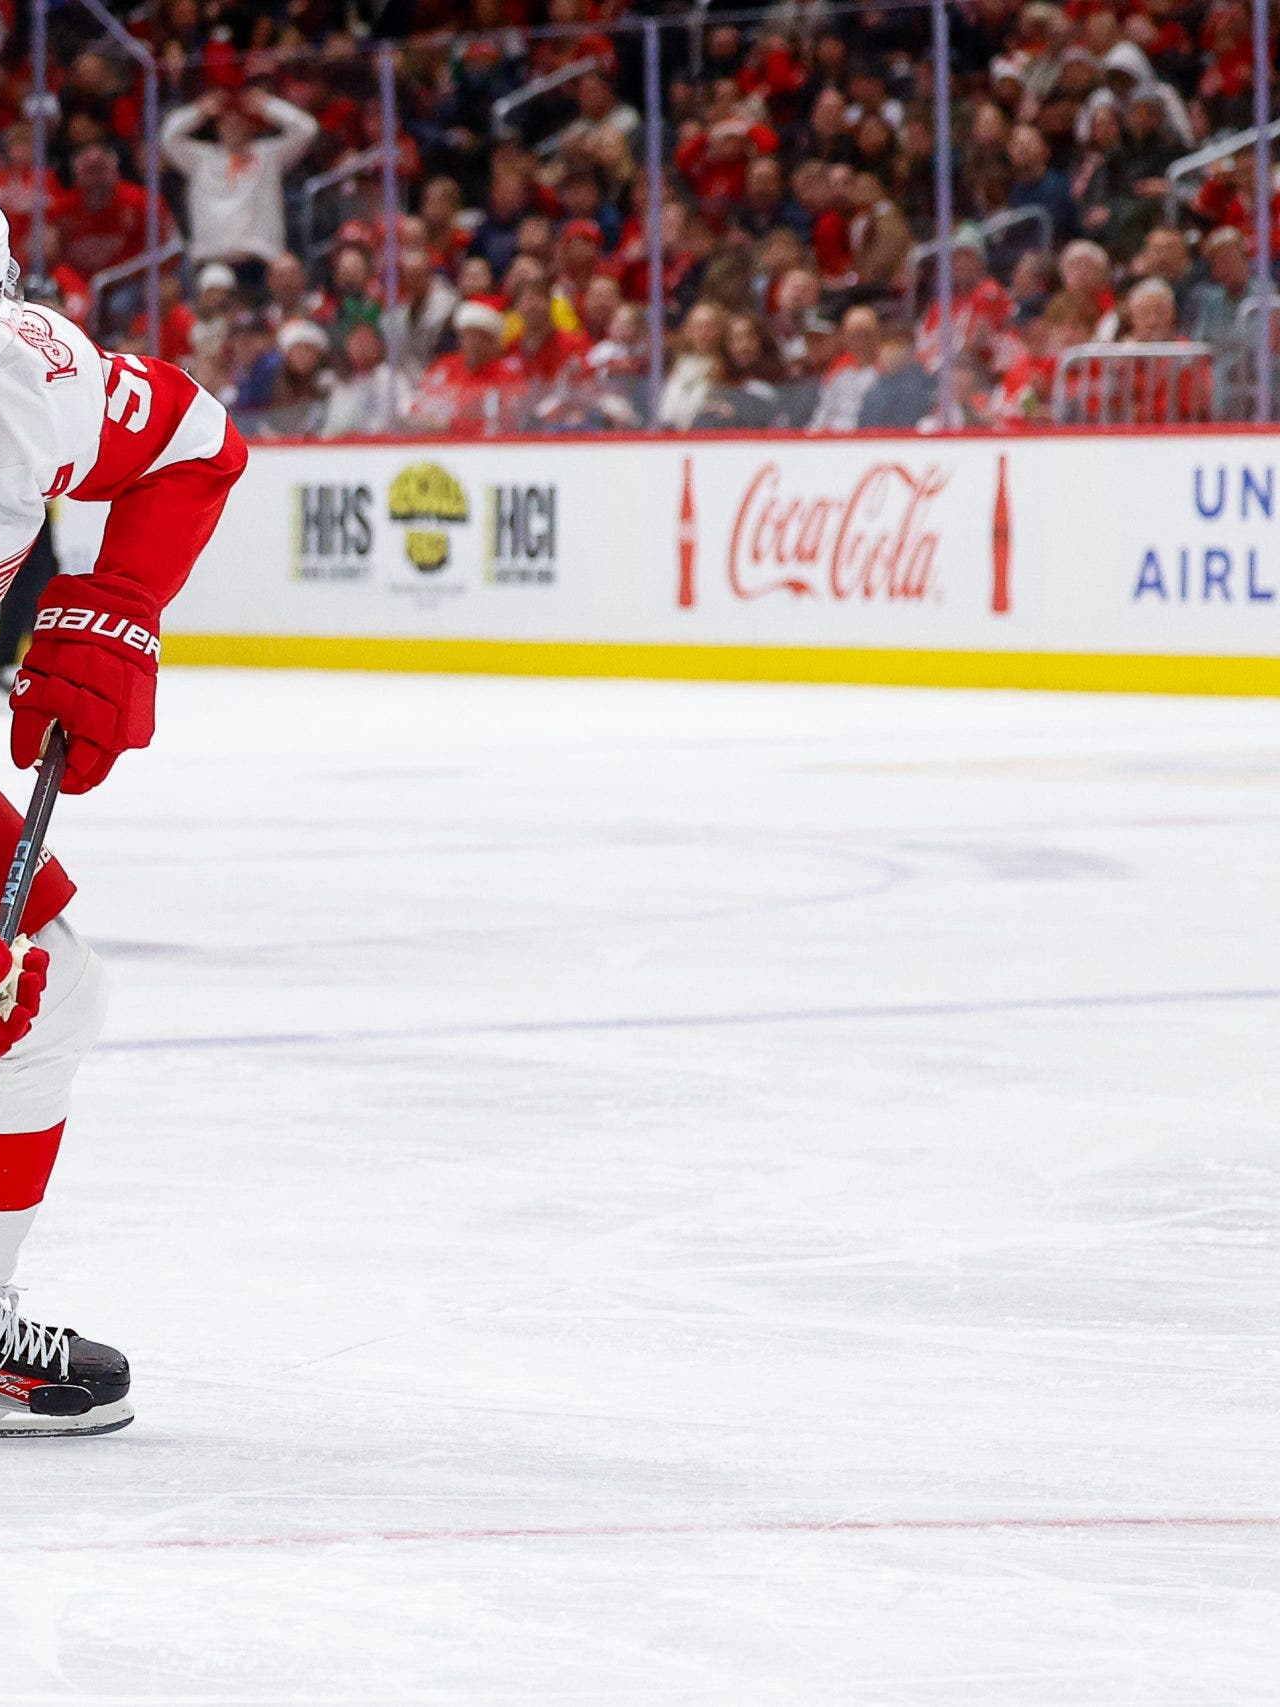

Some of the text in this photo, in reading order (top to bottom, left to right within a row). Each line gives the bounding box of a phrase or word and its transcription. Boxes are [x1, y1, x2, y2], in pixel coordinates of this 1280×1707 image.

[1193, 467, 1275, 517] UN
[1133, 549, 1276, 602] AIRL
[0, 840, 32, 905] CCM
